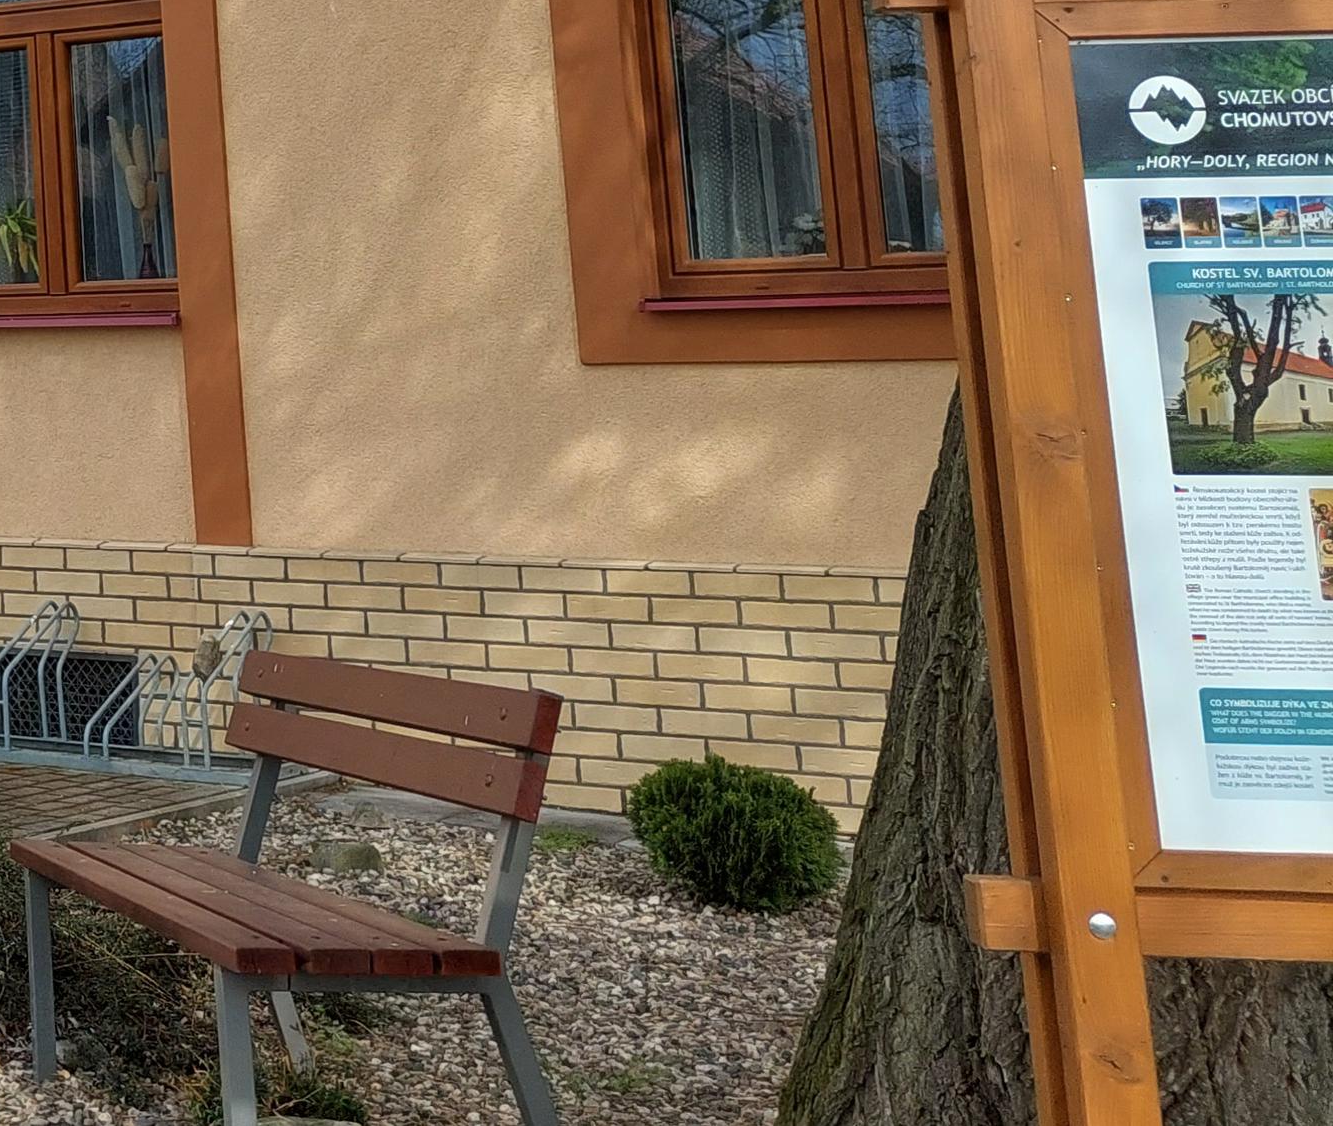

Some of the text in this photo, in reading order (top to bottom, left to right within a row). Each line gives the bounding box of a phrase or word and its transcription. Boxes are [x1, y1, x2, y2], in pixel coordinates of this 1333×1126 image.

[1217, 89, 1286, 106] SVAZEK
[1256, 153, 1319, 167] REGION
[1192, 268, 1240, 279] KOSTEL
[1243, 268, 1262, 279] SV.
[1210, 699, 1222, 707] CO
